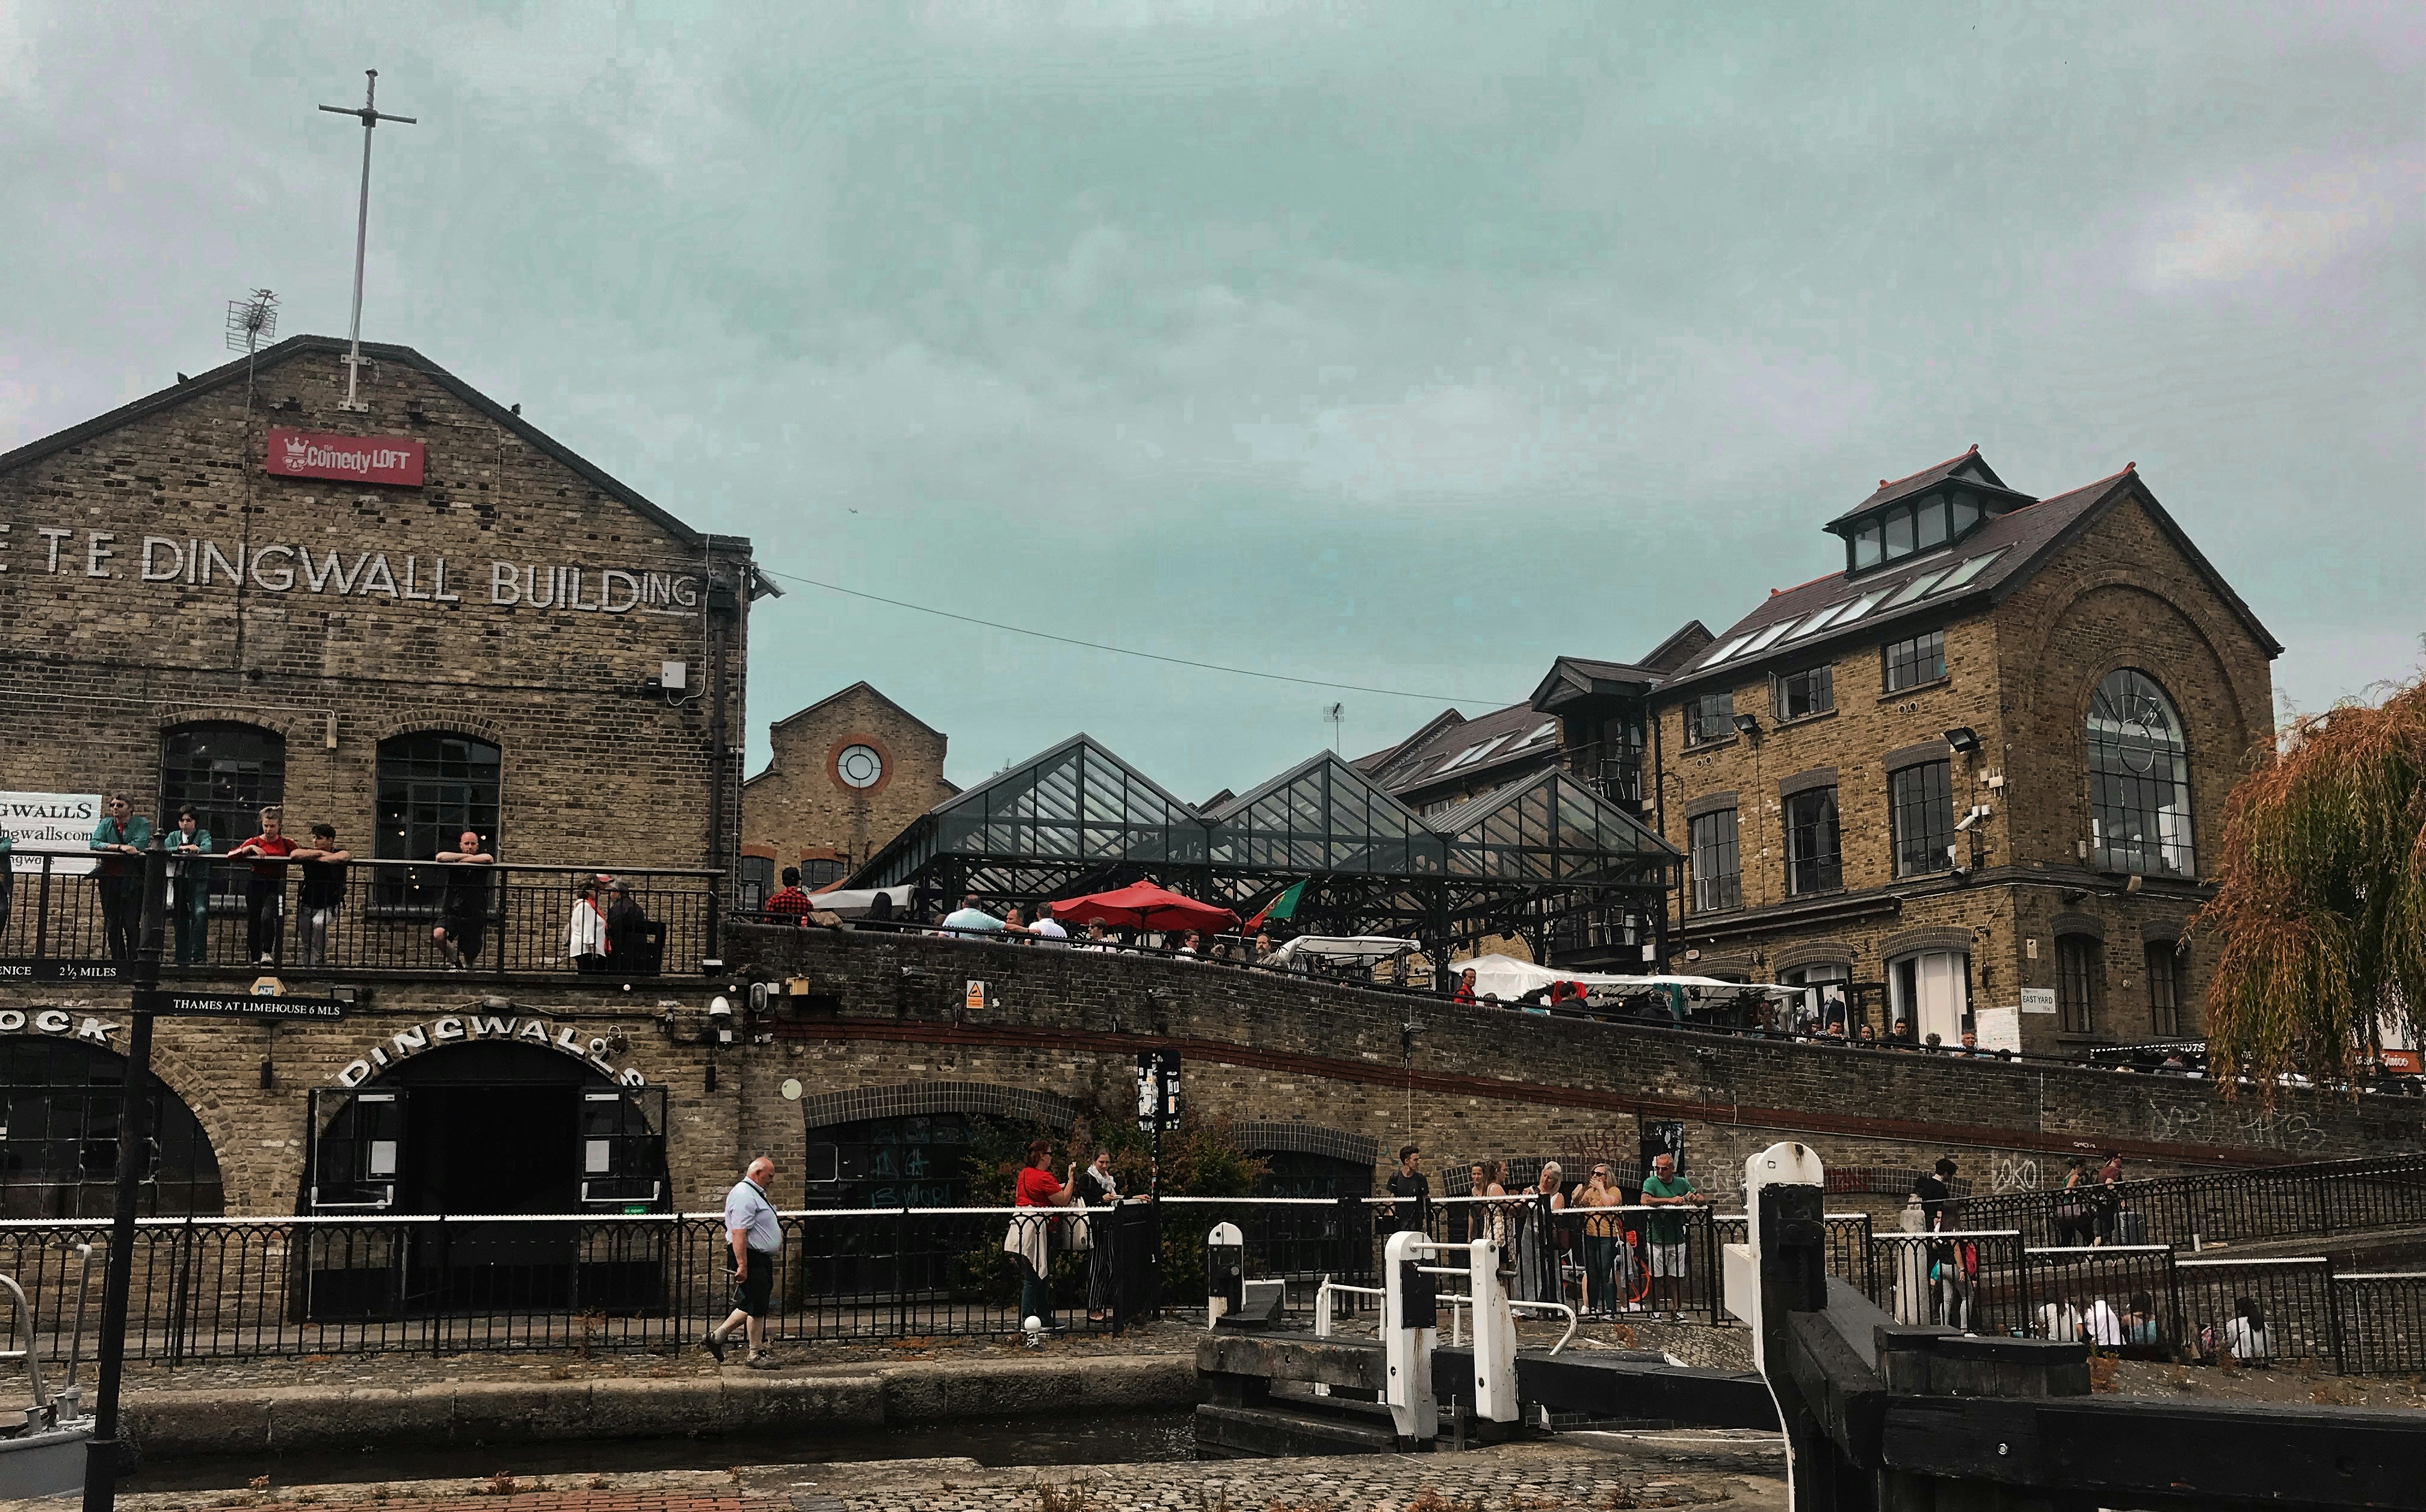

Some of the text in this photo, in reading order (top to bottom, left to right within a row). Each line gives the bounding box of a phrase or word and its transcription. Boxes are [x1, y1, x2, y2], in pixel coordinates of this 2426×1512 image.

[307, 446, 371, 474] Comedy
[372, 449, 410, 469] LOFT
[141, 535, 459, 602] DINGWALL
[491, 561, 699, 613] BUILDING
[81, 967, 117, 977] MILES
[258, 987, 274, 995] ADT
[173, 999, 340, 1015] THAMES AT LIMEHOUSE 6 MLS
[338, 1015, 644, 1087] DINGWALLS
